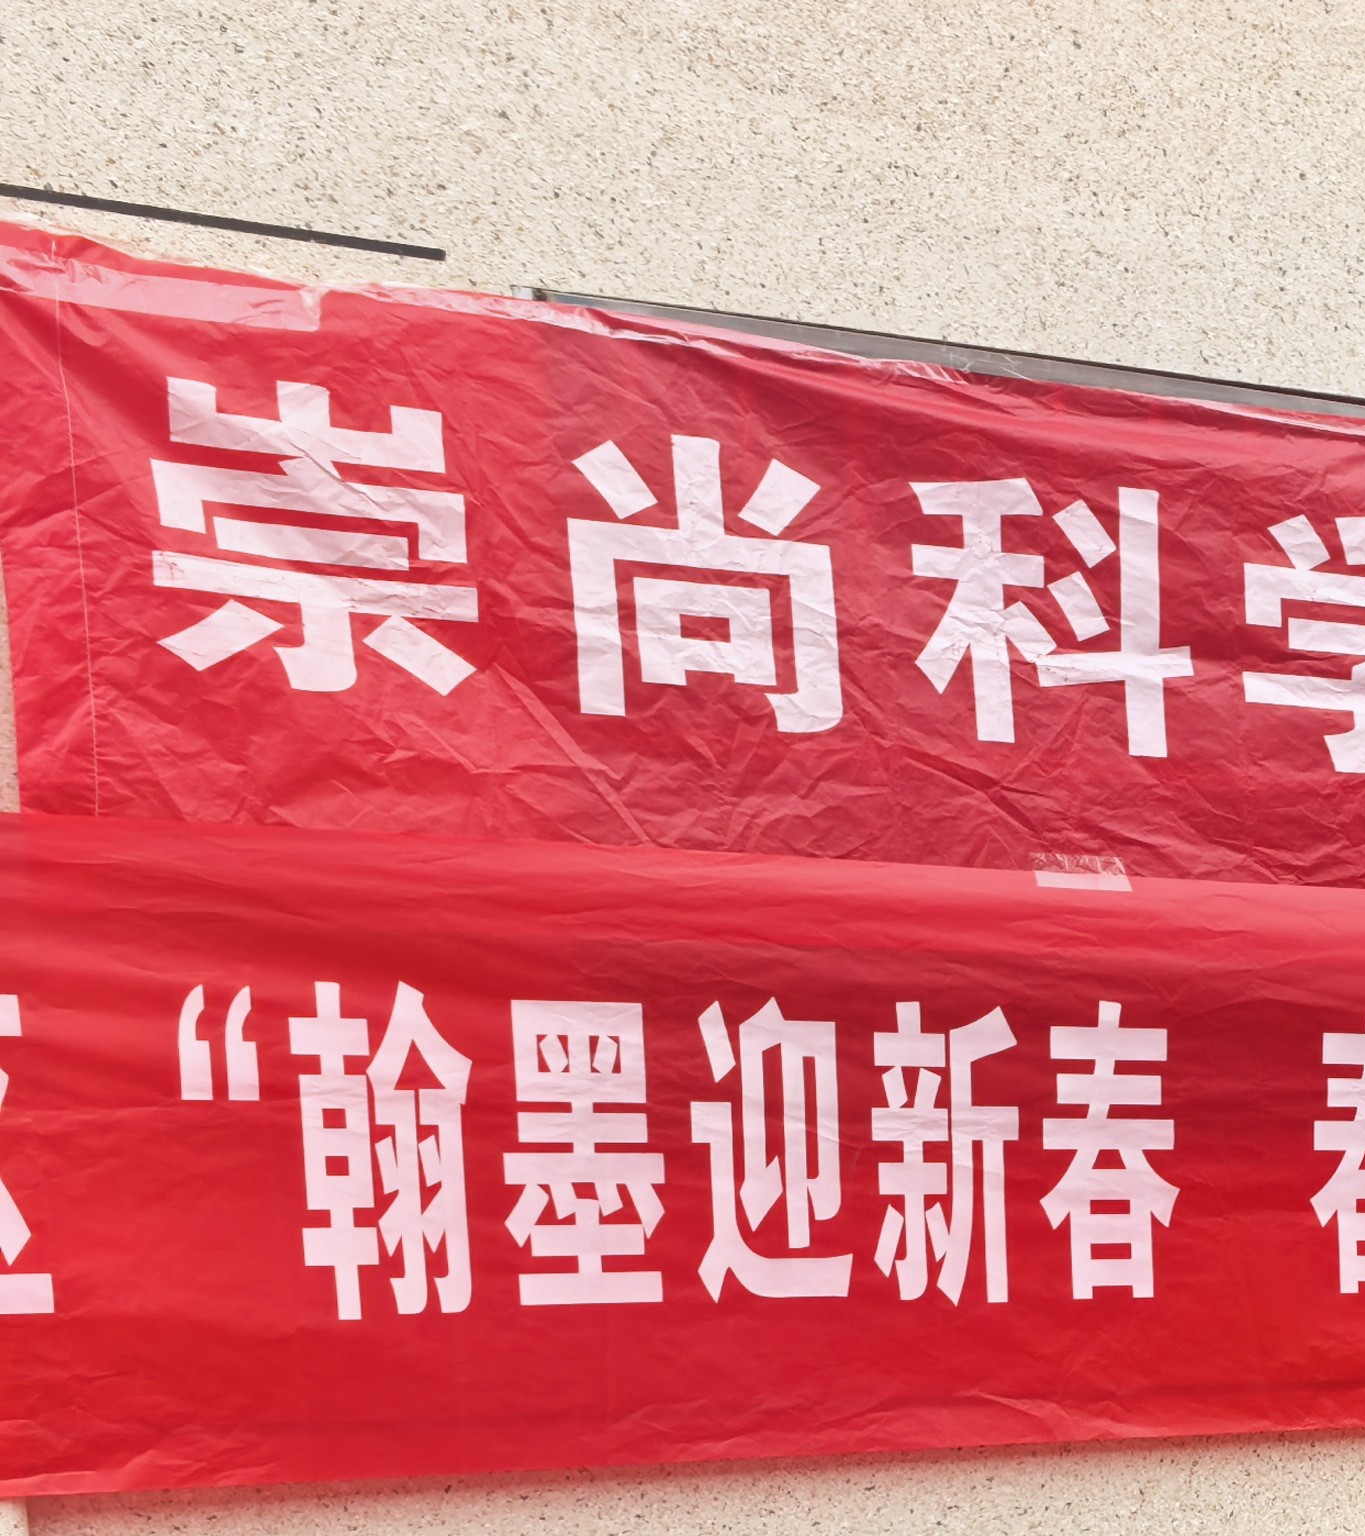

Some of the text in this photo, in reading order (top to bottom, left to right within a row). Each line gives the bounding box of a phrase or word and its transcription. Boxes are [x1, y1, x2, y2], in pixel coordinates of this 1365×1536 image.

[178, 981, 1180, 1320] “翰墨迎新春
